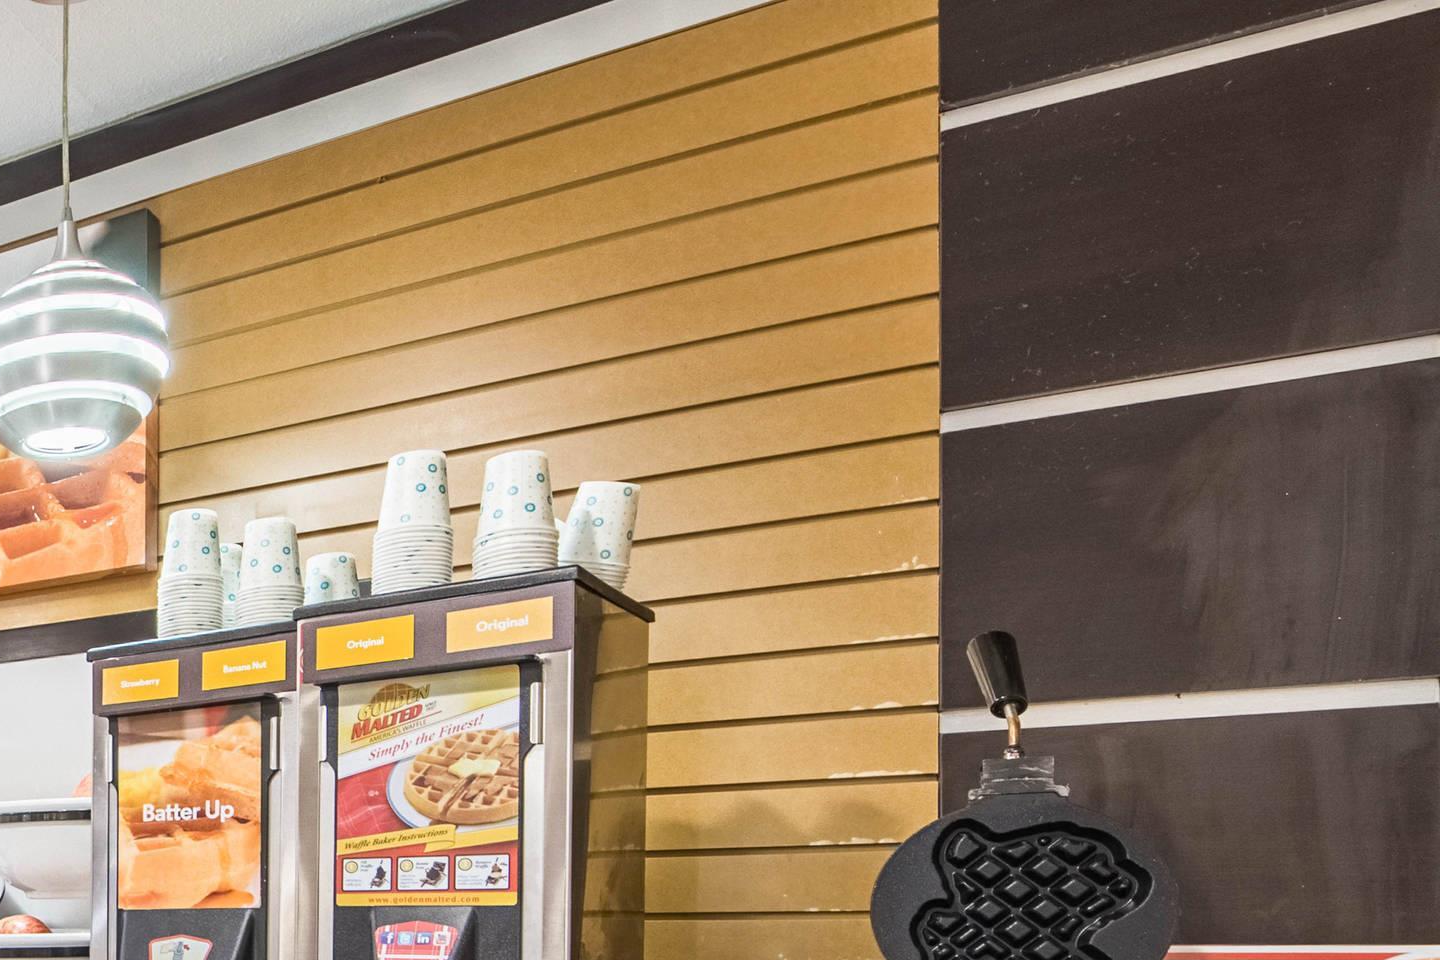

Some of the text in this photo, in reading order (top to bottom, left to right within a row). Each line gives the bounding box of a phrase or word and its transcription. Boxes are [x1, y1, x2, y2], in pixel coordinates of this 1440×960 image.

[475, 614, 530, 633] Original
[346, 636, 385, 650] Original
[222, 661, 268, 674] Banana Nut
[120, 678, 161, 689] Strawberry
[357, 683, 431, 721] GOLDEN
[350, 703, 424, 741] MALTED
[402, 719, 428, 732] WAFFLE
[368, 713, 485, 761] Simply the Finest!
[142, 799, 235, 824] Batter Up
[344, 828, 449, 850] Waffle Baker Instructions
[368, 895, 481, 905] www.goldenmalted.com
